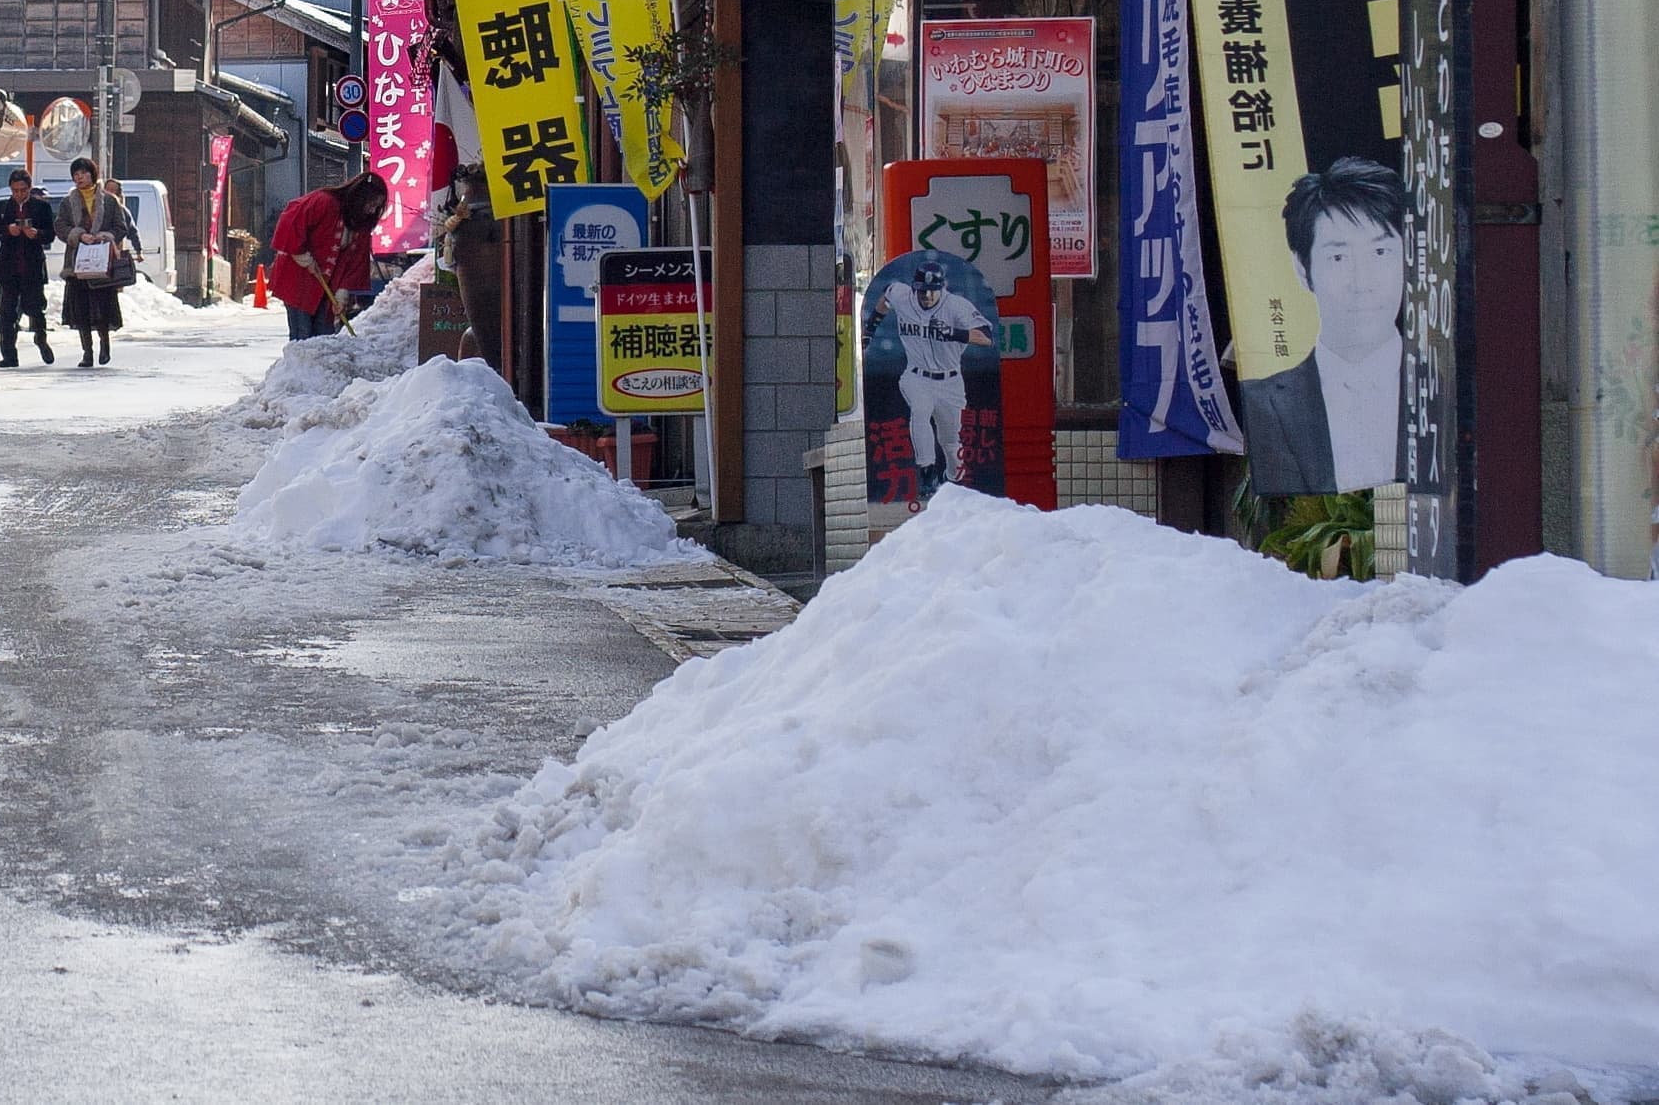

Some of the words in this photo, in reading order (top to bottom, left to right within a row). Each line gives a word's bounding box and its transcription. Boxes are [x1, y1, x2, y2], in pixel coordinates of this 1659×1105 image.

[930, 46, 1085, 81] いわむら城下町の
[343, 84, 361, 101] 30
[960, 70, 1052, 95] ひなまつり
[374, 31, 405, 229] ひなまつり
[571, 223, 616, 240] 最新の
[918, 208, 1030, 262] くすり
[624, 262, 697, 278] シーメンス
[616, 292, 700, 307] ドイツ生まれの
[1402, 64, 1419, 558] いわむら町商店
[610, 324, 713, 360] 補聴器
[1426, 119, 1440, 558] ふれあいスタ
[621, 375, 703, 392] きこえの相談室
